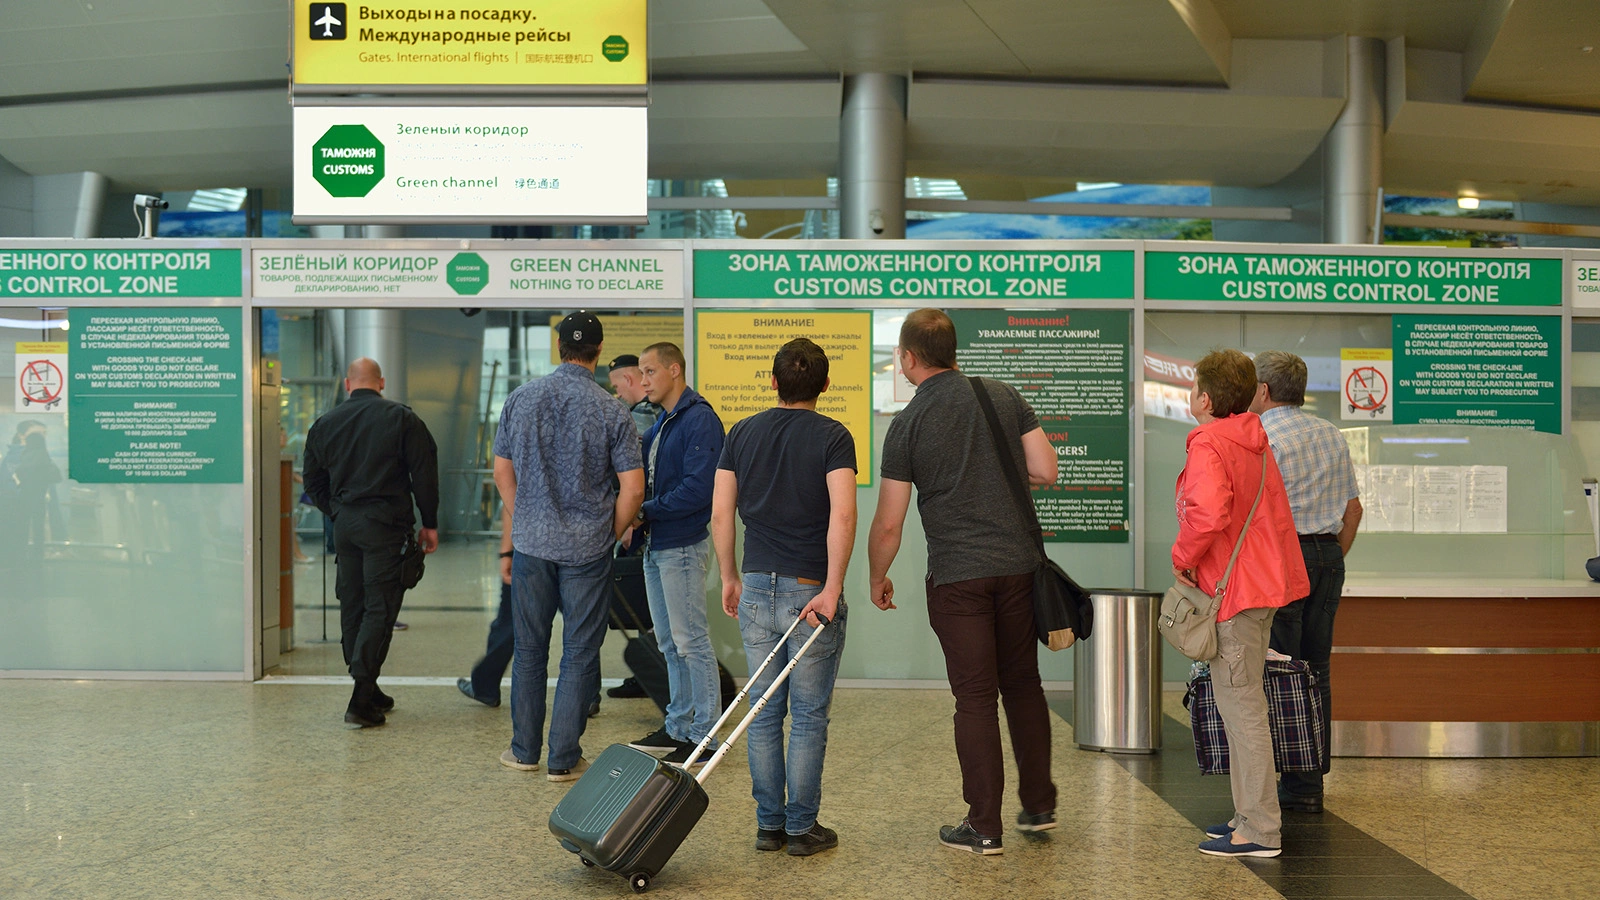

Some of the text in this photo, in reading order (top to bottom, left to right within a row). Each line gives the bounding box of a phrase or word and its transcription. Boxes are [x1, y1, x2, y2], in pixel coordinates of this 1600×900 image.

[359, 6, 536, 23] Выходы на посадку.
[359, 28, 571, 45] Международные рейсы
[358, 51, 509, 65] Gates. International flights
[525, 53, 594, 64] 国际航班登机口
[397, 123, 529, 136] Зеленый коридор
[320, 147, 376, 158] ТАМОЖНЯ
[322, 164, 375, 175] CUSTOMS
[396, 176, 498, 188] Green channel
[0, 252, 211, 271] ЕННОГО КОНТРОЛЯ
[260, 254, 439, 271] ЗЕЛЁНЫЙ КОРИДОР
[510, 258, 663, 273] GREEN CHANNEL
[728, 253, 1101, 272] ЗОНА ТАМОЖЕННОГО КОНТРОЛЯ
[1178, 255, 1531, 280] ЗОНА ТАМОЖЕННОГО КОНТРОЛЯ
[260, 274, 439, 283] ТОВАРОВ, ПОДЛЕЖАЩИХ ПИСЬМЕННОМУ
[7, 276, 113, 294] CONTROL
[118, 276, 178, 294] ZONE
[294, 284, 401, 293] ДЕКЛАРИРОВАНИЮ, НЕТ
[510, 278, 664, 291] NOTHING TO DECLARE
[773, 277, 1067, 296] CUSTOMS CONTROL ZONE
[1221, 280, 1499, 303] CUSTOMS CONTROL ZONE
[753, 318, 815, 327] ВНИМАНИЕ!
[1007, 314, 1070, 327] Внимание!
[978, 329, 1100, 338] УВАЖАЕМЫЕ ПАССАЖИРЫ!
[821, 343, 859, 351] сажиров.
[106, 356, 204, 364] CROSSING THE CHECK-LINE
[91, 364, 219, 372] WITH GOODS YOU DID NOT DECLARE
[1430, 363, 1523, 372] CROSSING THE CHECK-LINE
[74, 372, 237, 380] ON YOUR CUSTOMS DECLARATION IN WRITTEN
[1415, 371, 1538, 380] WITH GOODS YOU DID NOT DECLARE
[90, 380, 221, 388] MAY SUBJECT YOU TO PROSECUTION
[704, 383, 739, 391] Entrance
[828, 383, 864, 392] channels
[1399, 379, 1554, 388] ON YOUR CUSTOMS DECLARATION IN WRITTEN
[1415, 387, 1539, 396] MAY SUBJECT YOU TO PROSECUTION
[721, 393, 847, 403] only for depart engers.
[721, 404, 733, 412] No
[129, 442, 182, 450] PLEASE NOTE!
